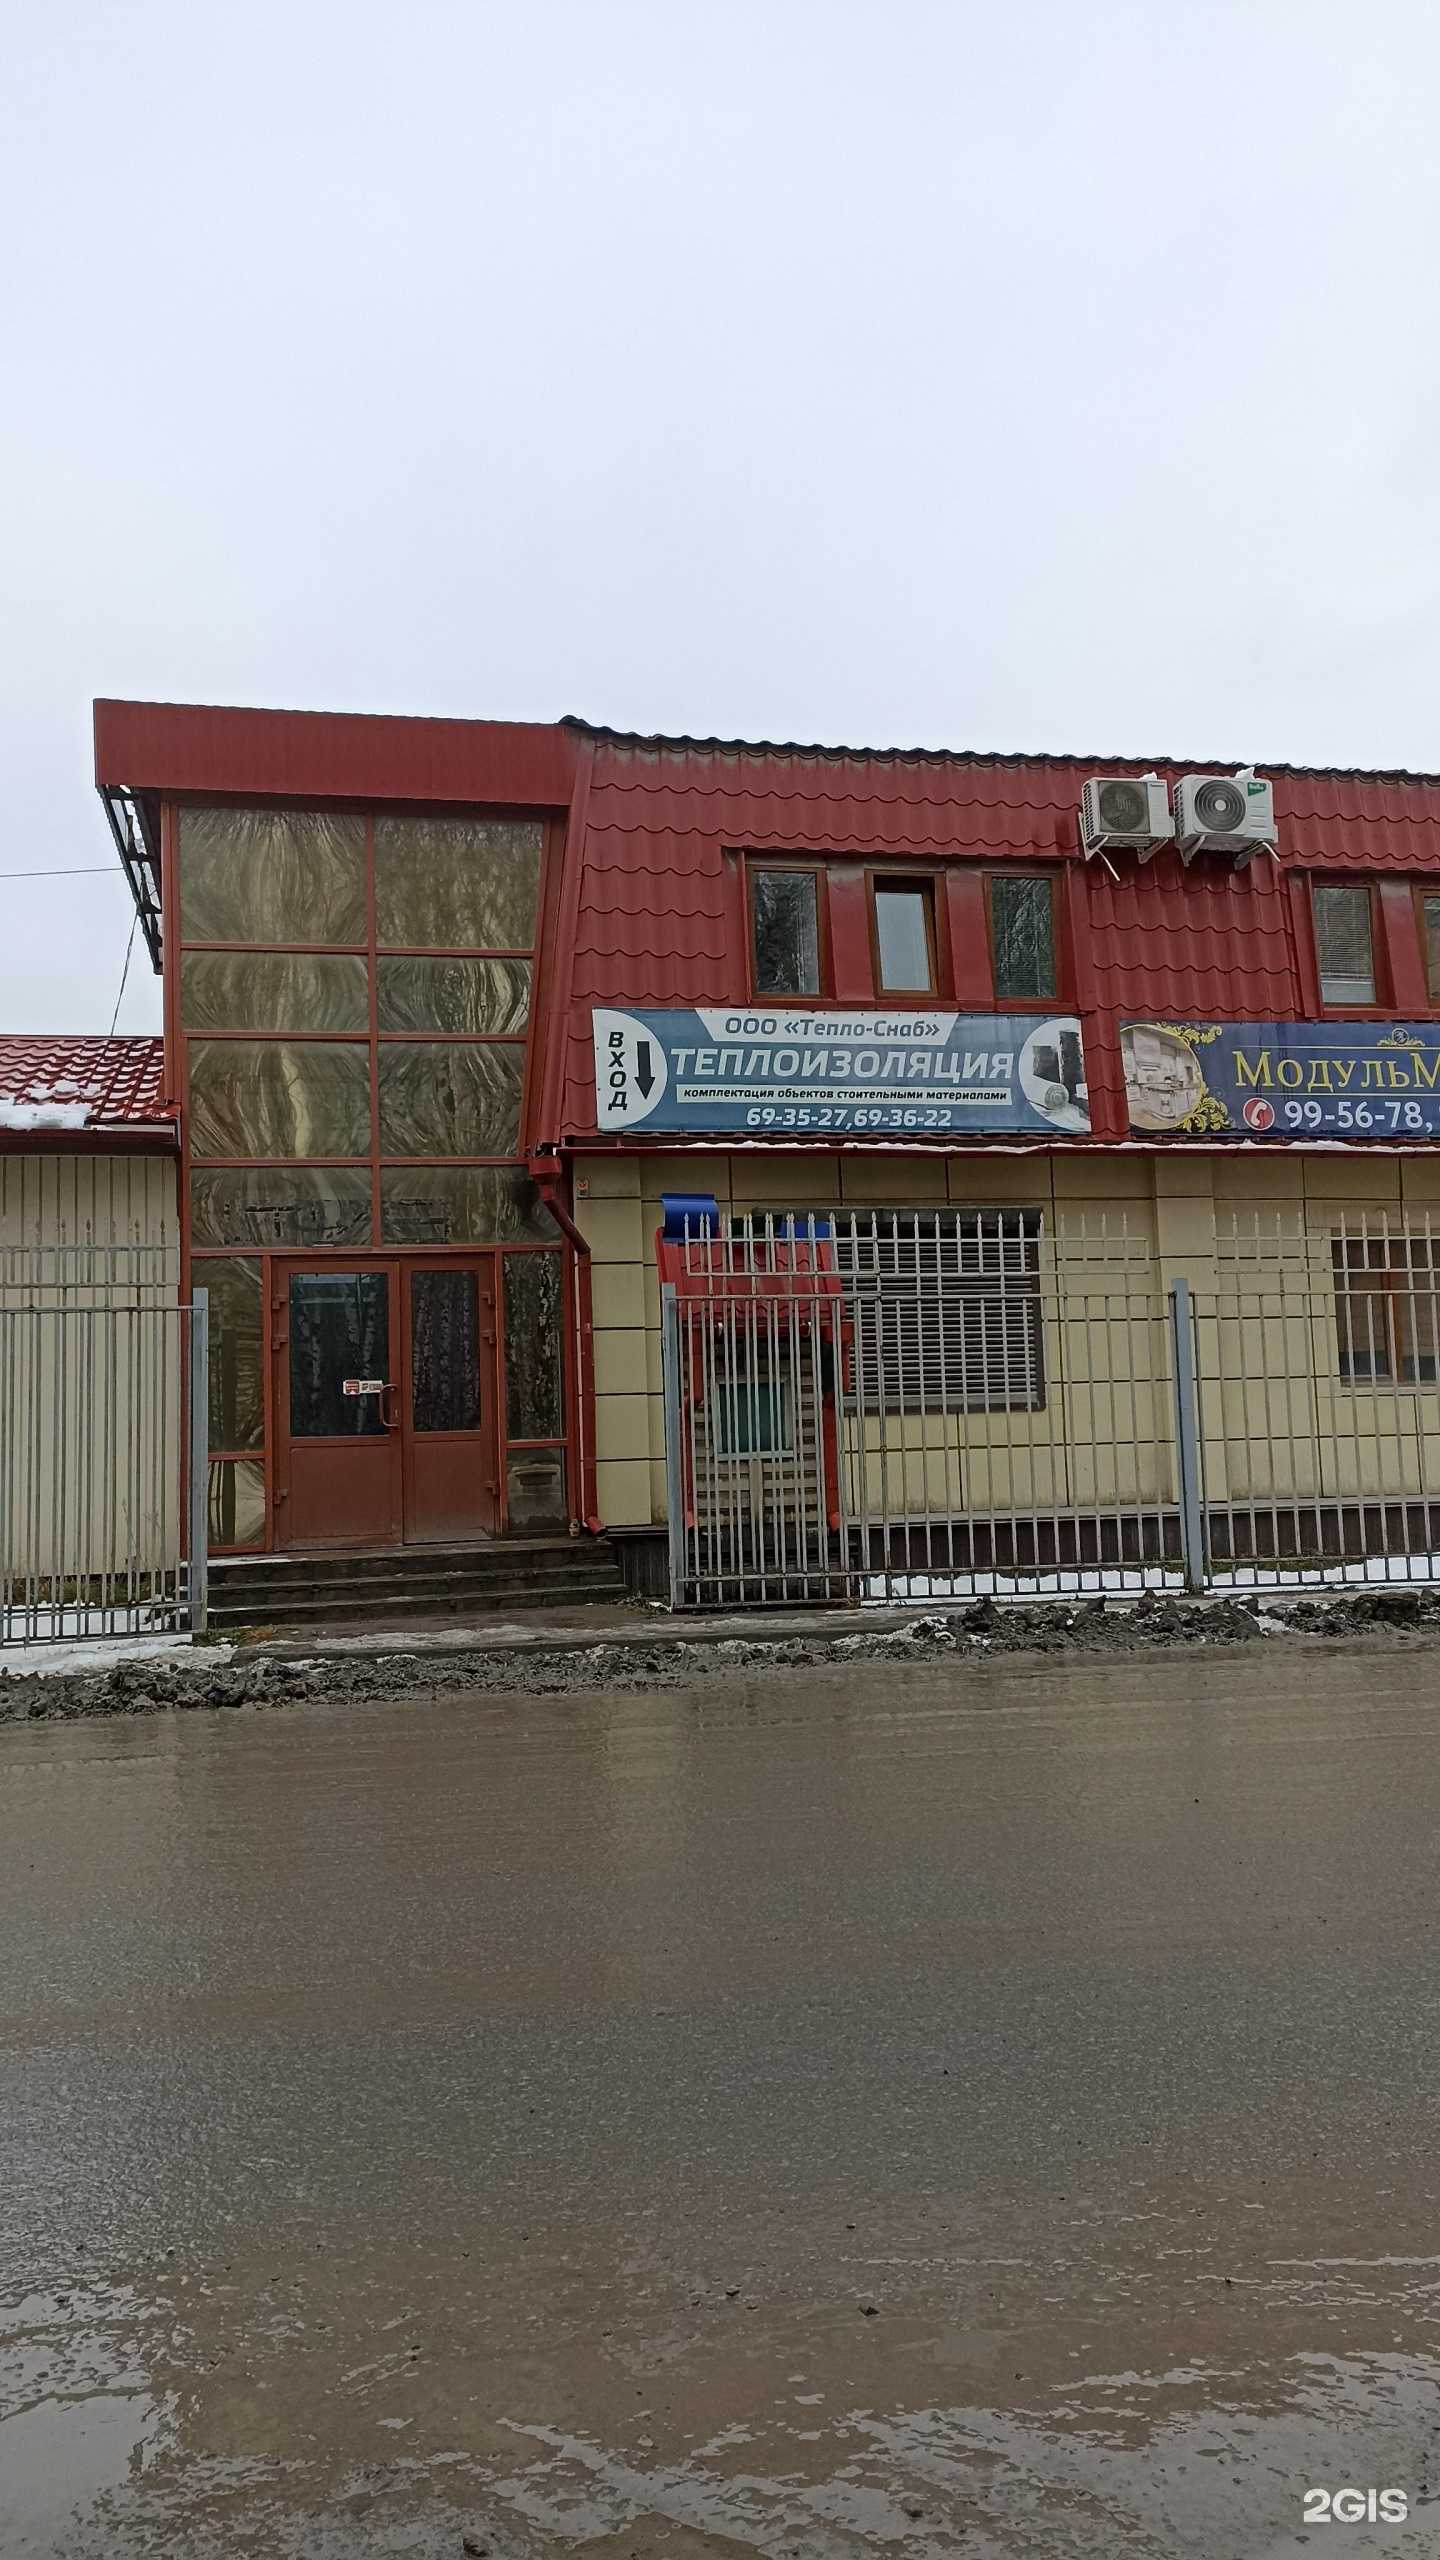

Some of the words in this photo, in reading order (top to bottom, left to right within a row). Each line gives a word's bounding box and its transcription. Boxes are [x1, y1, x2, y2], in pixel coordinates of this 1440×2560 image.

[725, 1017, 777, 1035] ООО
[784, 1018, 940, 1038] «Тепло-Снаб»
[608, 1031, 628, 1111] ВХОД
[671, 1048, 1014, 1083] ТЕПЛОИЗОЛЯЦИЯ
[684, 1088, 774, 1099] комплектация
[777, 1088, 834, 1099] объектов
[926, 1091, 1007, 1101] материалами
[746, 1107, 952, 1130] 69-35-27,69-36-22
[1284, 1101, 1433, 1133] 99-56-78,
